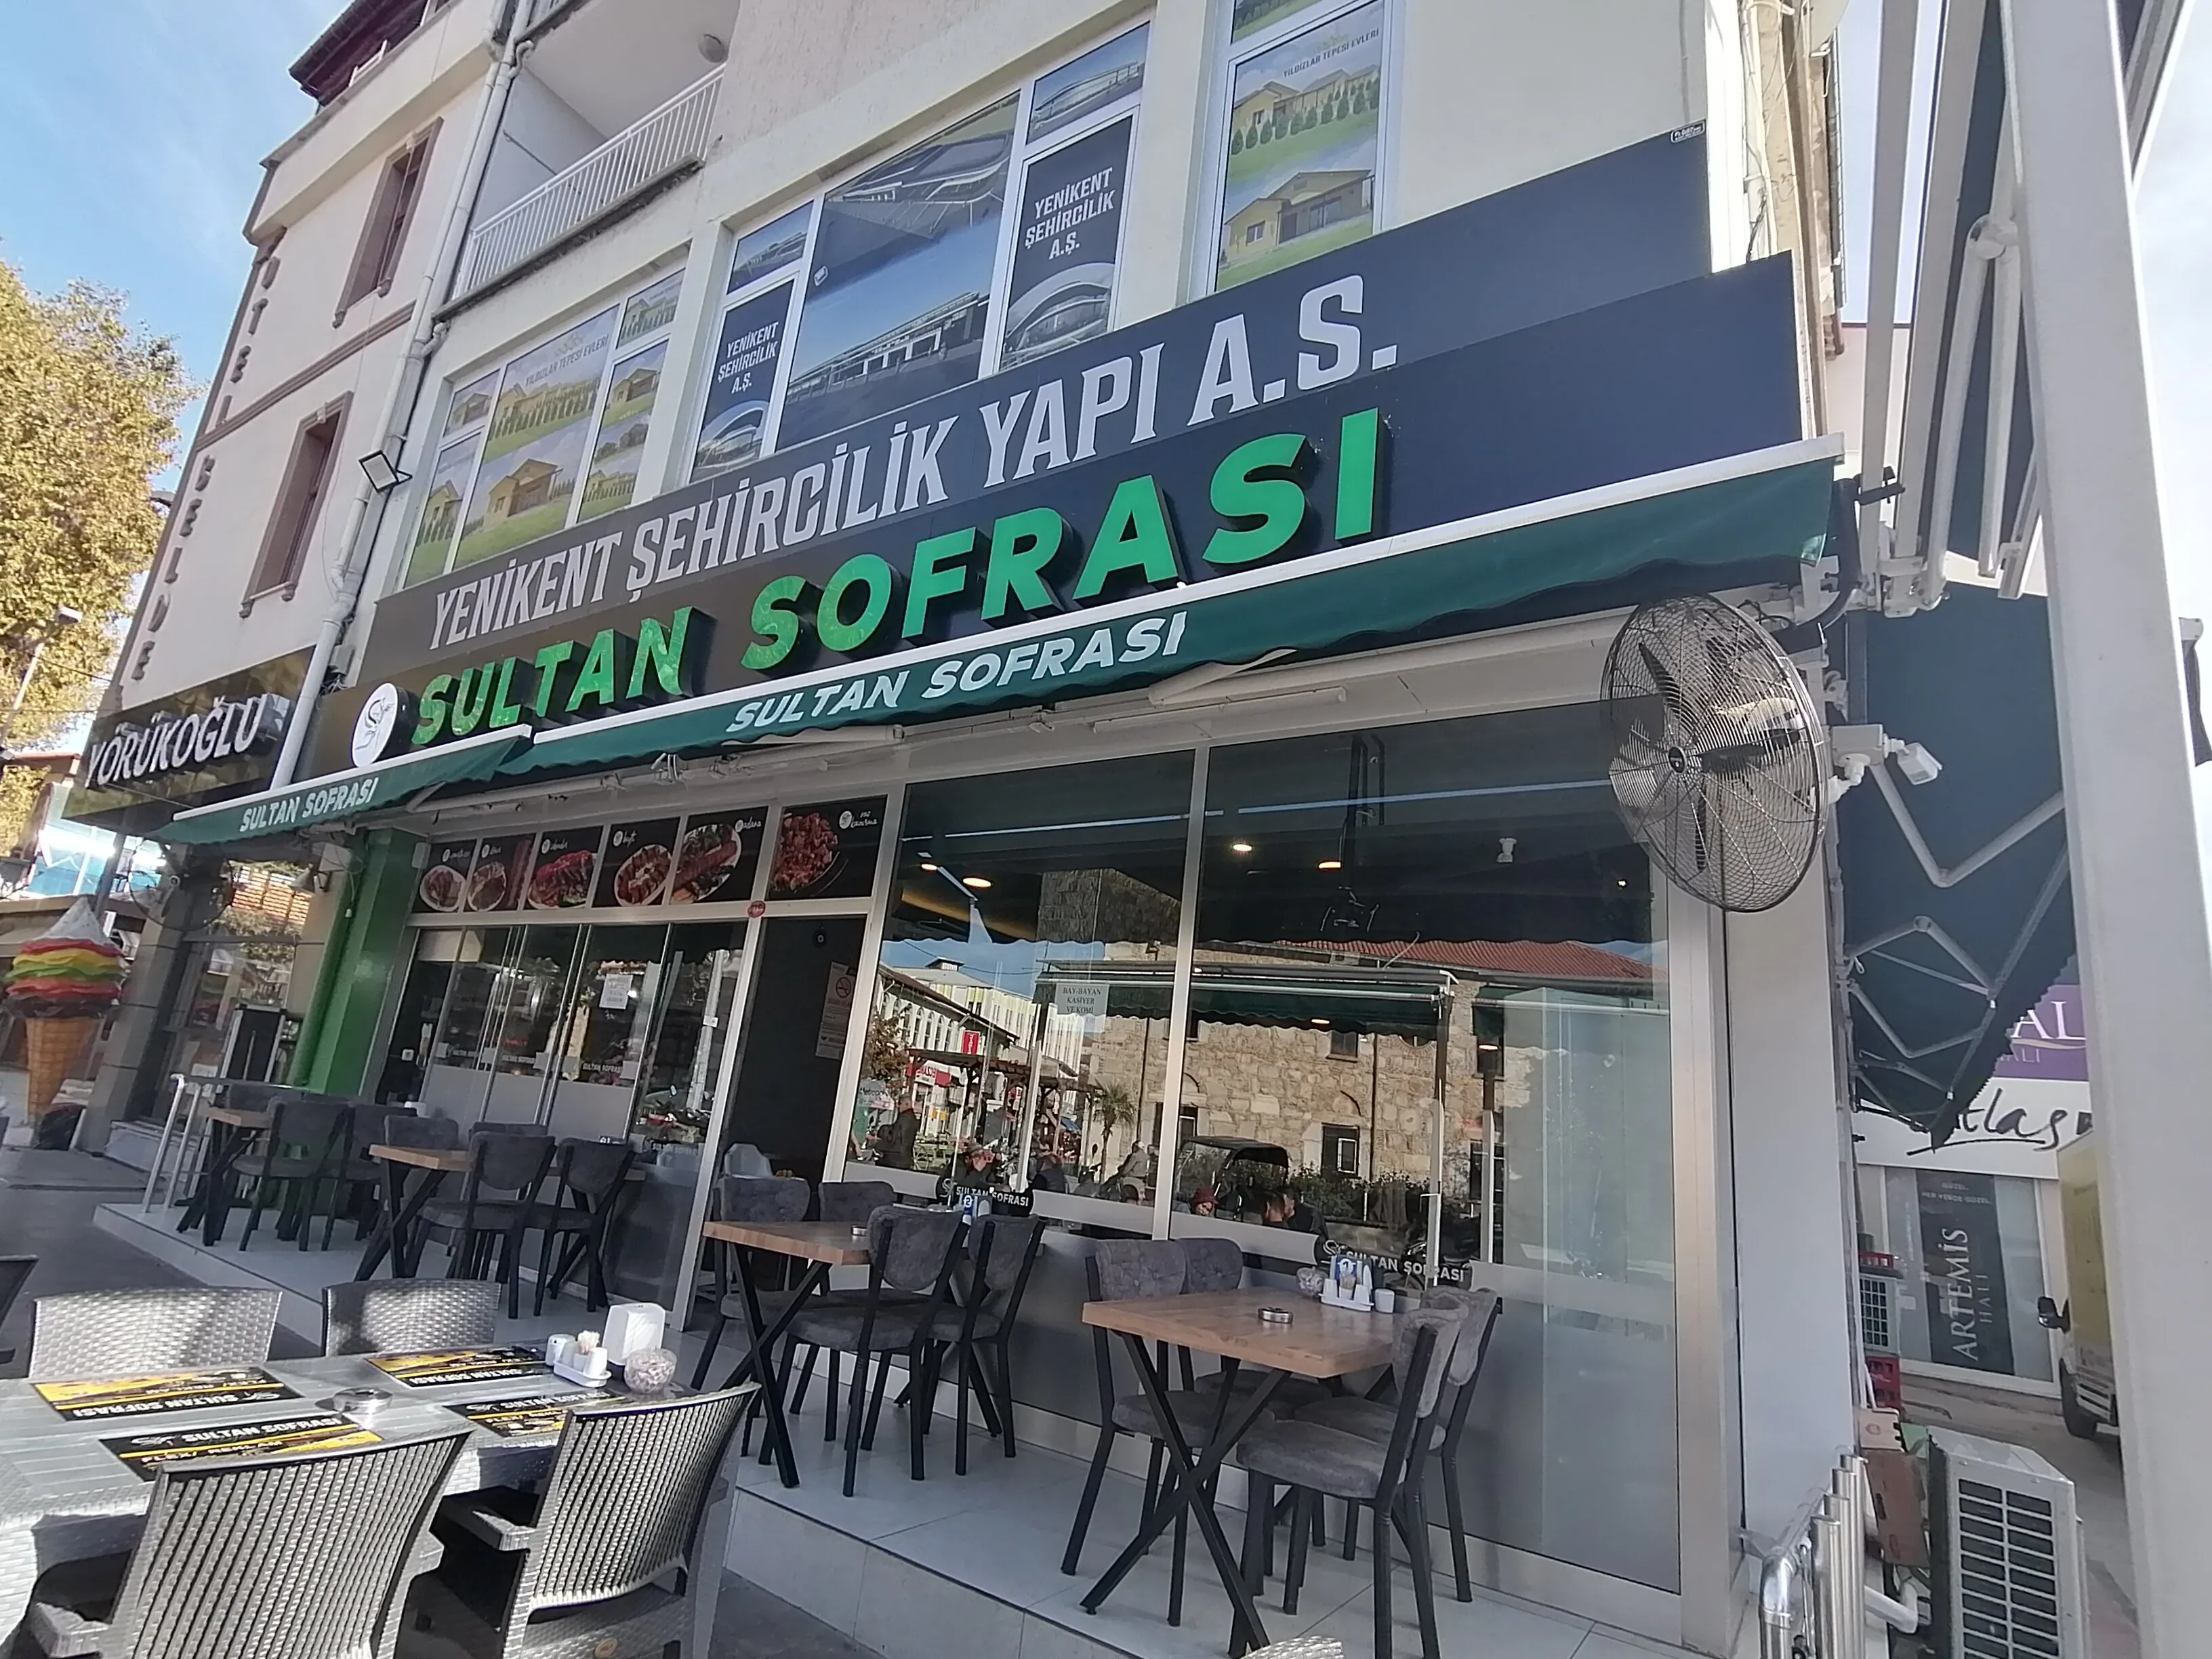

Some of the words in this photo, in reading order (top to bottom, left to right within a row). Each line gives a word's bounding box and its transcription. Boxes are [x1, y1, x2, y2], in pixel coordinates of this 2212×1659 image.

[1035, 167, 1113, 220] YENİKENT
[1025, 190, 1115, 249] ŞEHİRCİLİK
[1048, 231, 1080, 260] A.Ş.
[718, 340, 779, 383] ŞEHİRCİLİK
[726, 321, 779, 358] YENİKENT
[731, 372, 752, 394] A.Ş.
[429, 531, 623, 651] YENİKENT
[626, 415, 961, 603] ŞEHİRCİLİK
[979, 342, 1166, 489] YAPI
[411, 606, 695, 745] SULTAN
[740, 407, 1379, 670] SOFRASI
[725, 670, 909, 733] SULTAN
[921, 611, 1188, 699] SOFRASI
[85, 693, 268, 789] YÖRÜKOĞLU
[240, 796, 300, 833] SULTAN
[302, 778, 380, 819] SOFRASI
[1063, 987, 1101, 996] BAY-BAYAN
[1938, 1227, 1979, 1362] ARTEMİS
[73, 1401, 164, 1418] SOFRASI
[165, 1393, 239, 1408] SULTAN
[181, 1425, 260, 1443] SULTAN
[262, 1417, 342, 1434] SOFRASI
